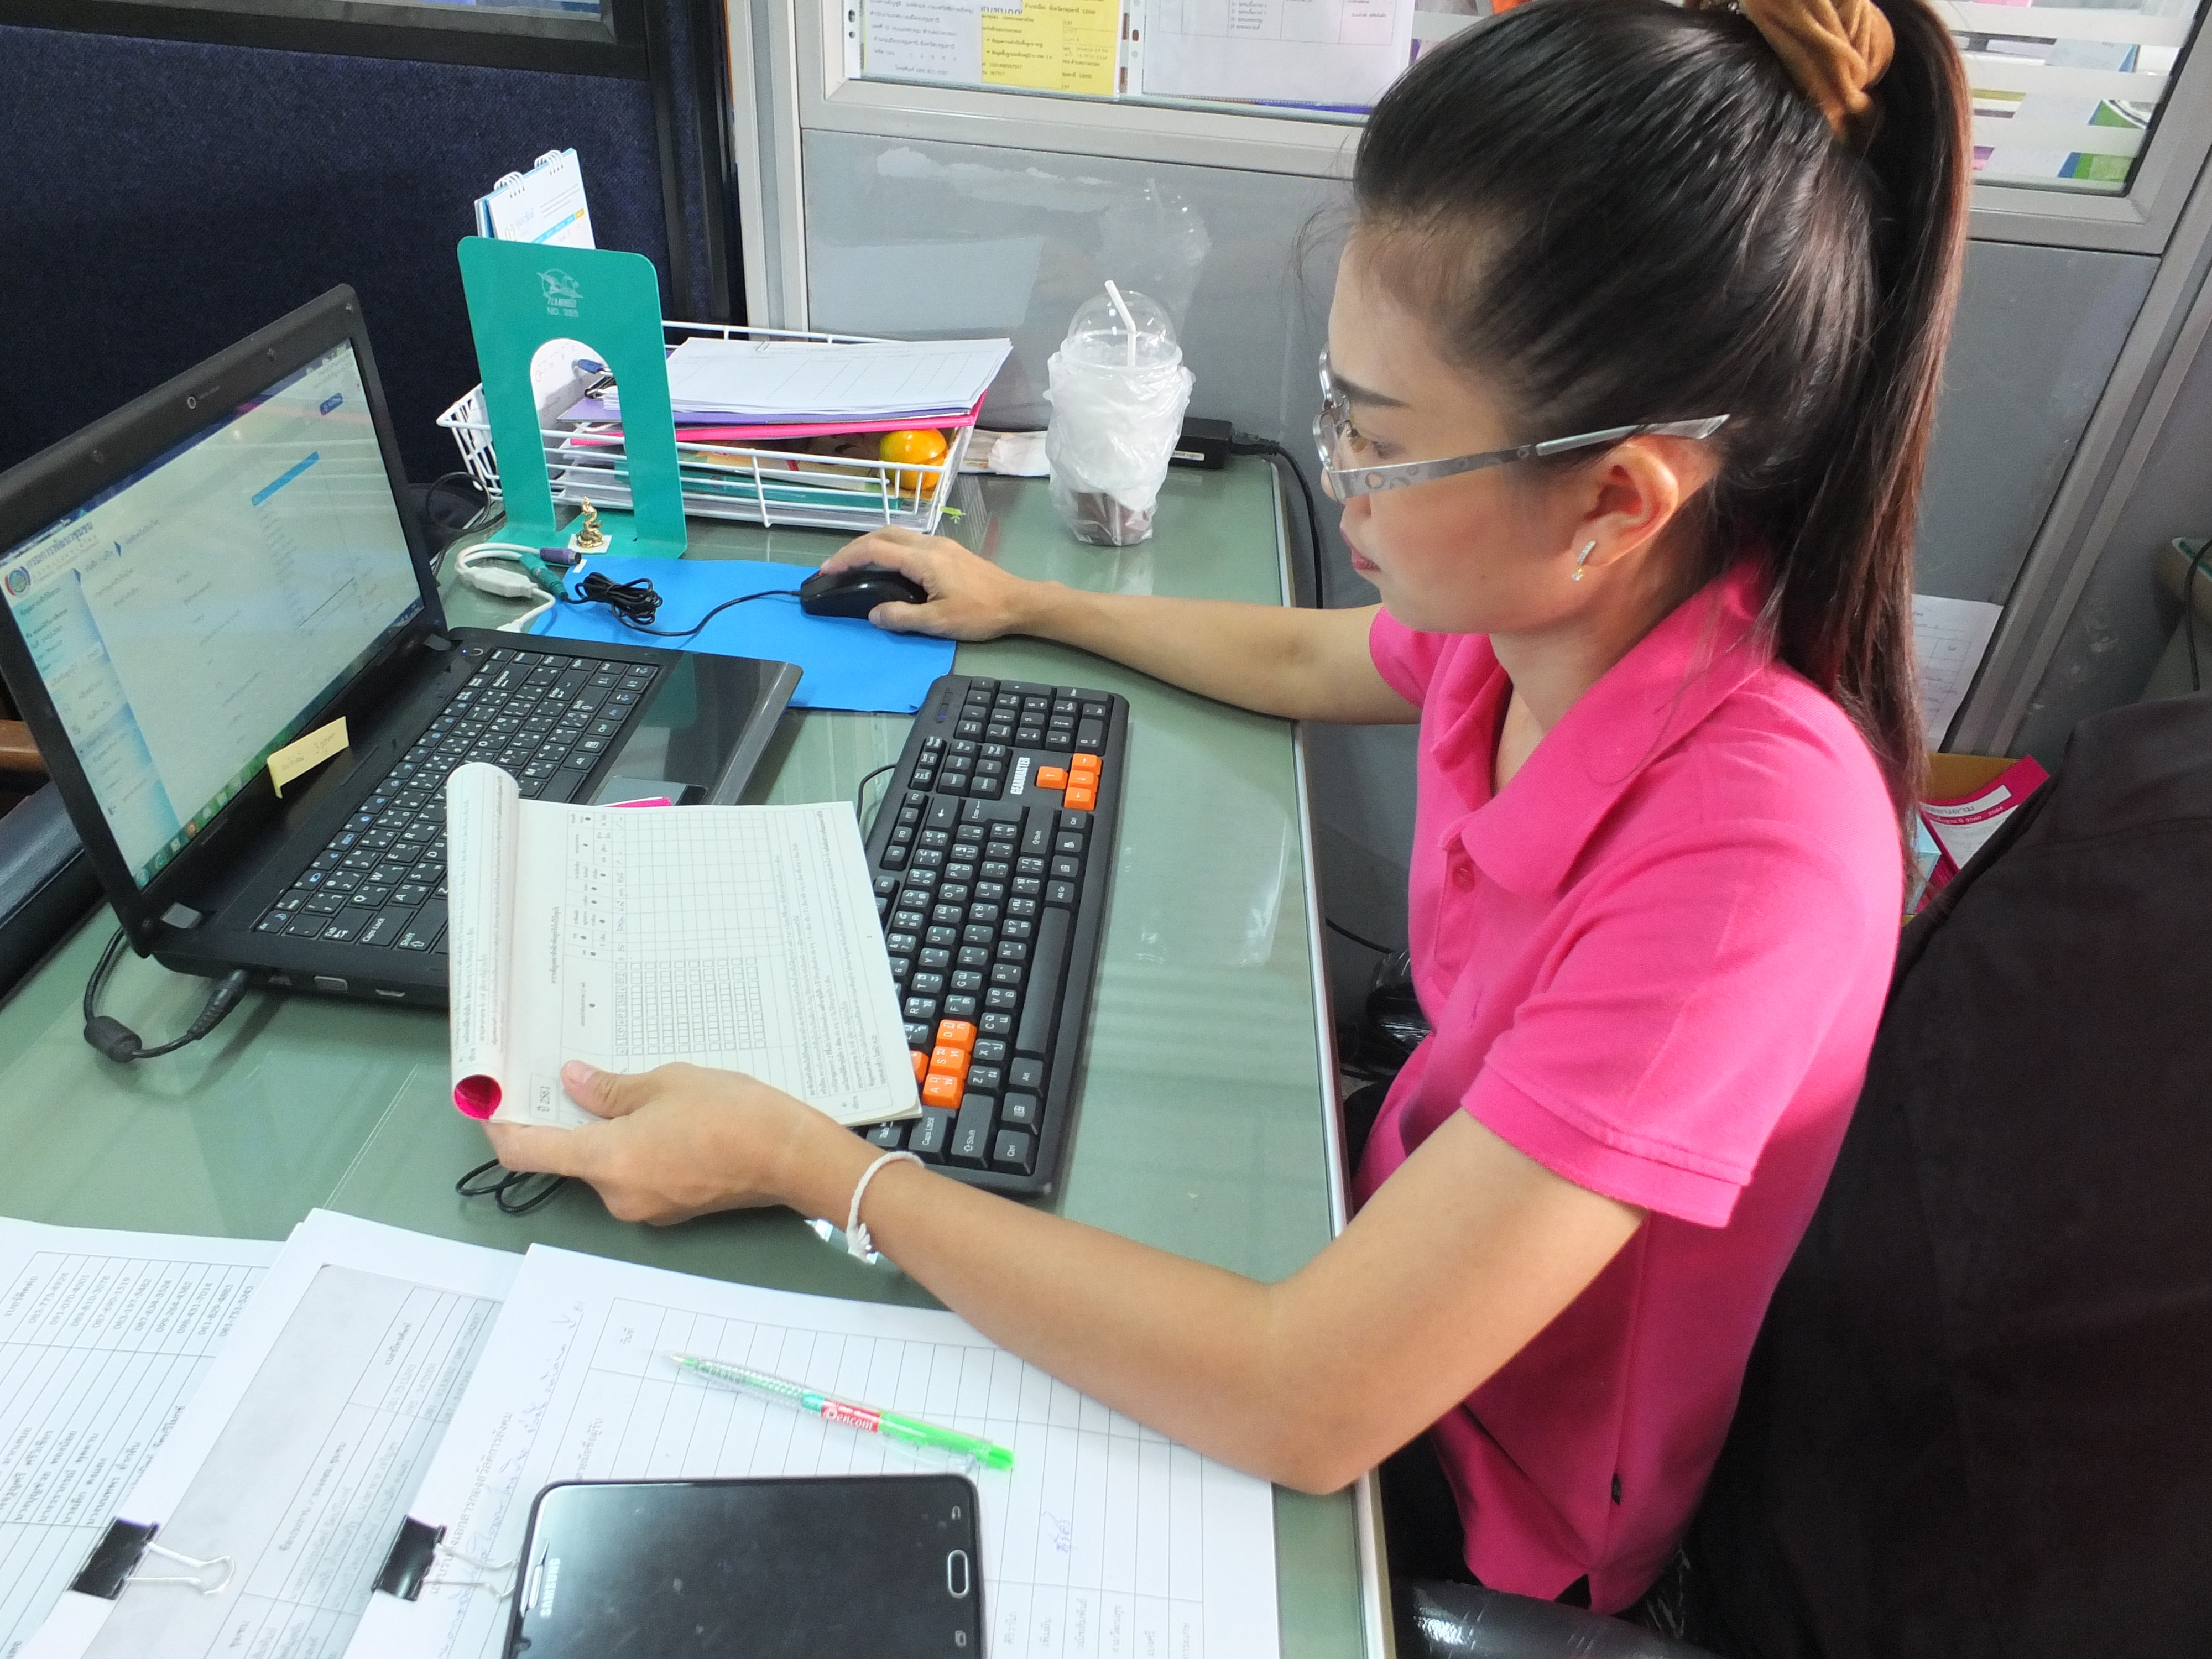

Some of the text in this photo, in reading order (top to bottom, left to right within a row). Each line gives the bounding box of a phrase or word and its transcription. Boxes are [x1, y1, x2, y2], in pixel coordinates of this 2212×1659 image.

[1010, 757, 1030, 795] GEARMASTER
[922, 1131, 931, 1145] Caps
[967, 1130, 976, 1145] Shift
[1007, 1145, 1015, 1156] Ctrl
[220, 1285, 254, 1337] 081-751-5243
[823, 1407, 874, 1431] Pencom
[540, 1558, 560, 1618] SAMSUNG
